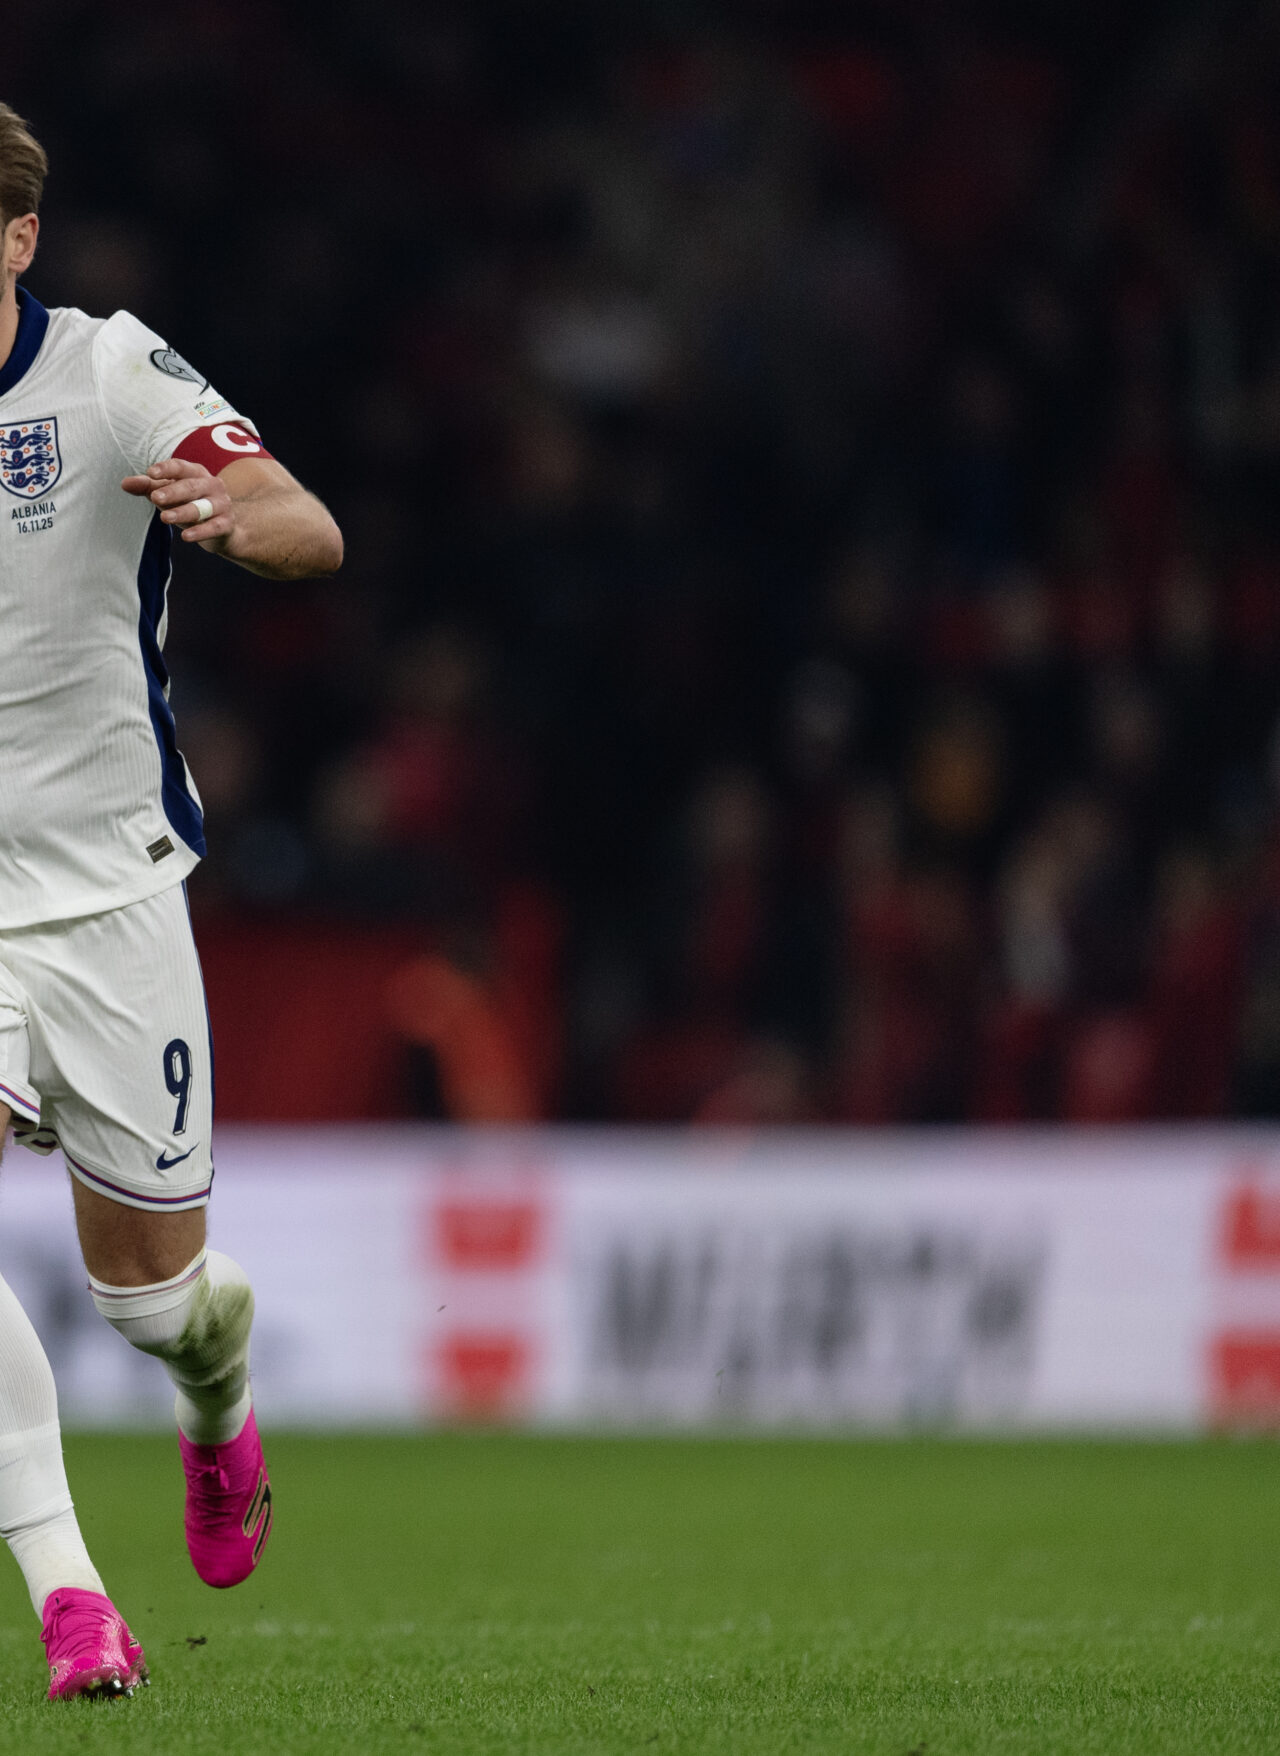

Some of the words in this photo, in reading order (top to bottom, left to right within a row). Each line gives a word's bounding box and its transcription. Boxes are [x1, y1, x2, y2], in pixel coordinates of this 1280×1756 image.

[211, 424, 260, 453] C
[11, 501, 57, 520] ALBANIA
[17, 517, 54, 534] 16.11.25
[163, 1038, 193, 1136] 9
